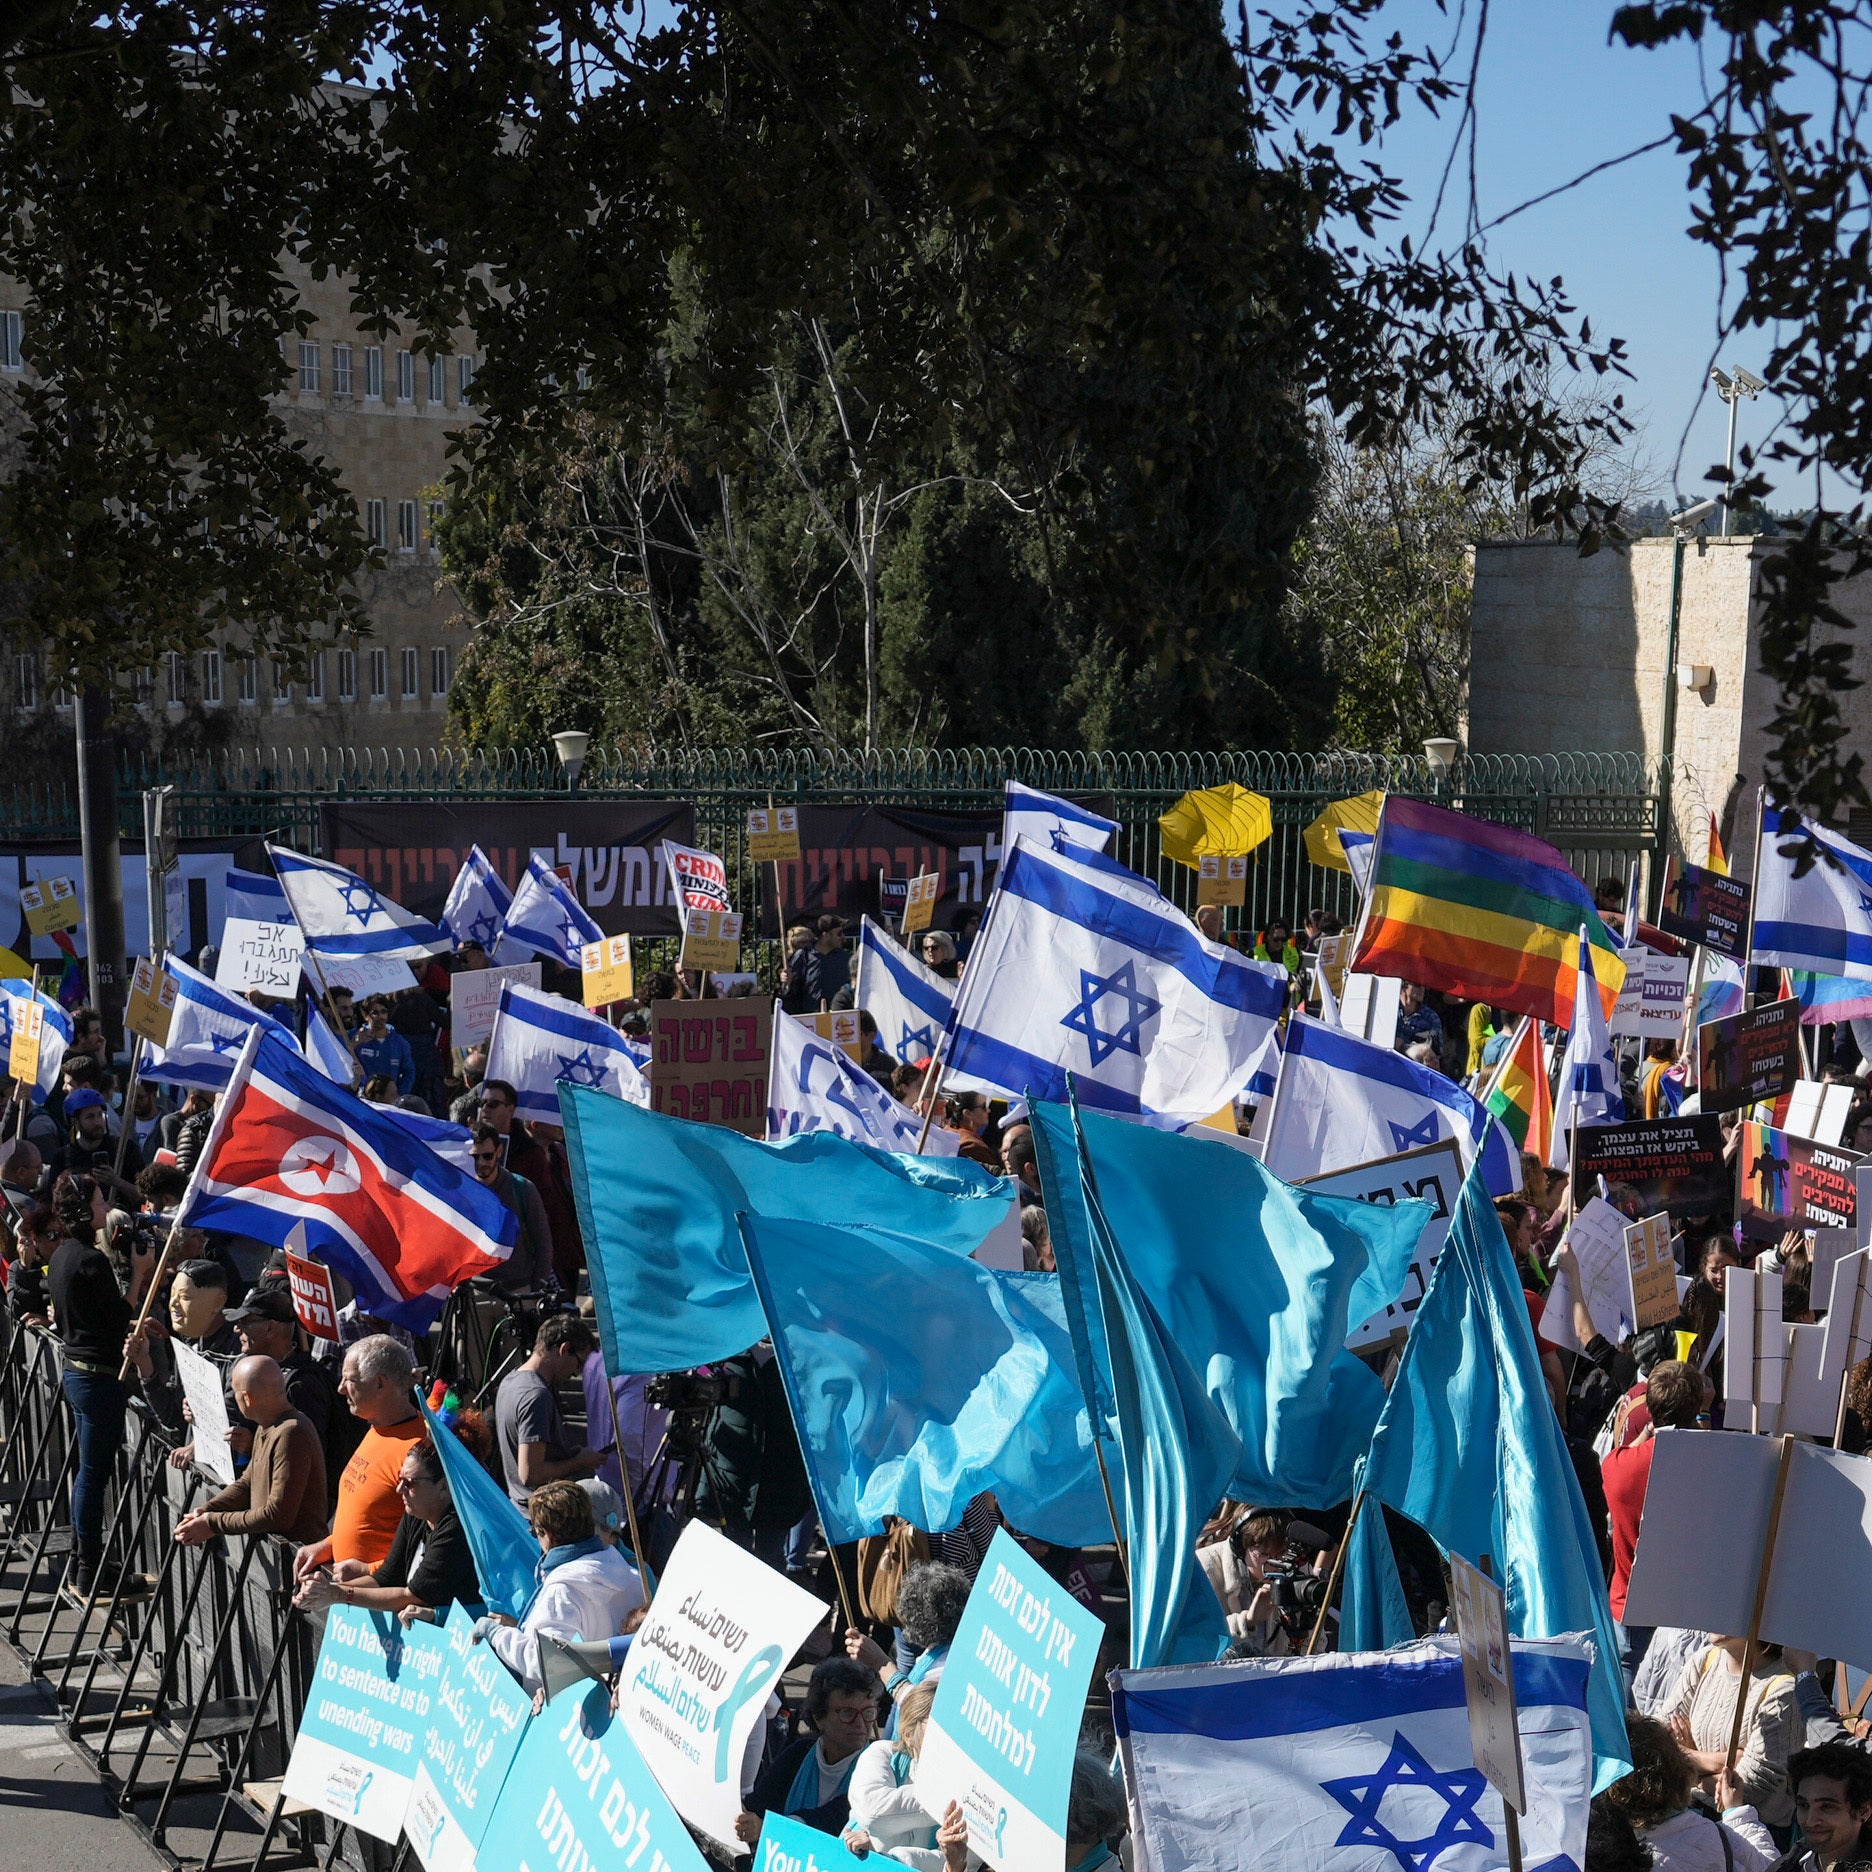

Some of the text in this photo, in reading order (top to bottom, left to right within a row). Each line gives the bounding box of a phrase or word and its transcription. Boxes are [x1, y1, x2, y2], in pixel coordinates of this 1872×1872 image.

[1714, 878, 1744, 897] נתניהו,
[258, 921, 286, 942] אל
[1708, 912, 1738, 933] בשטח!
[239, 940, 299, 963] תתגברו
[94, 963, 113, 974] 162
[95, 974, 113, 984] 103
[596, 991, 621, 1004] Shame
[1644, 985, 1683, 997] זכויות
[658, 1015, 765, 1062] בושה
[1751, 1053, 1785, 1073] בשטח!
[655, 1078, 765, 1121] וחרפה!
[1639, 1130, 1659, 1141] את
[1661, 1127, 1694, 1140] תציל
[1664, 1140, 1700, 1152] ביקש
[1580, 1151, 1715, 1172] מהי העדפתך המינית?
[1647, 1143, 1663, 1153] אז
[1655, 1167, 1666, 1178] לו
[1667, 1166, 1692, 1178] ענה
[1793, 1161, 1845, 1191] מפקירים
[1805, 1202, 1848, 1229] בשטח!
[1653, 1301, 1680, 1321] HaShem
[987, 1561, 1024, 1617] זכות
[678, 1589, 711, 1632] نساء
[1017, 1590, 1052, 1643] לכם
[709, 1607, 750, 1654] נשים
[1044, 1618, 1077, 1669] אין
[331, 1614, 443, 1680] You have no right
[684, 1641, 729, 1692] עושות
[975, 1624, 1053, 1720] לדון אותנו
[322, 1654, 431, 1718] to sentence us to
[677, 1689, 712, 1734] שלום
[319, 1698, 415, 1755] unending wars
[639, 1705, 702, 1767] WOMEN WAGE PEACE
[960, 1681, 1037, 1776] למלחמות
[558, 1699, 612, 1802] זכות
[598, 1777, 651, 1870] לכם
